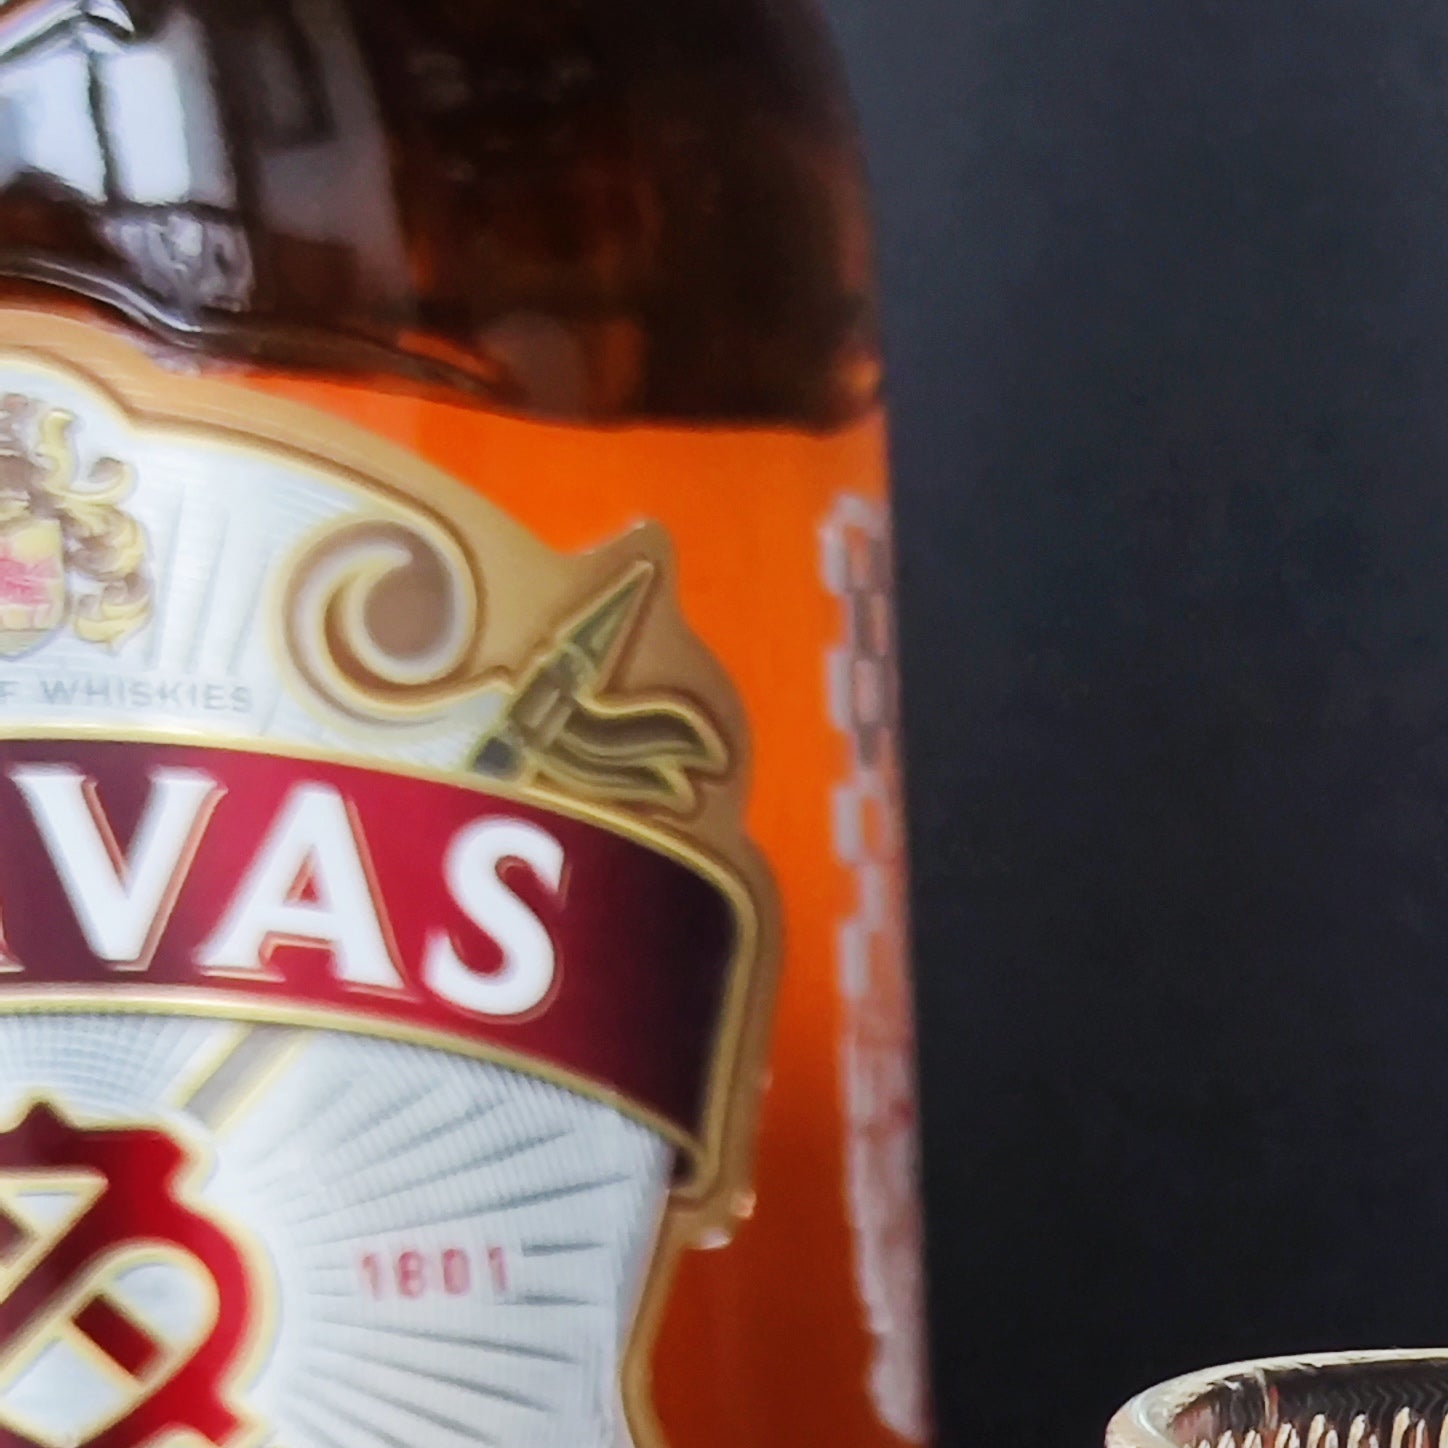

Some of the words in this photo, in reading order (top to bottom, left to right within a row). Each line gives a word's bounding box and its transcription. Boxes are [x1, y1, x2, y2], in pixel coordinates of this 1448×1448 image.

[40, 680, 253, 713] WHISKIES
[0, 763, 572, 1024] VAS
[361, 1246, 508, 1302] 1801
